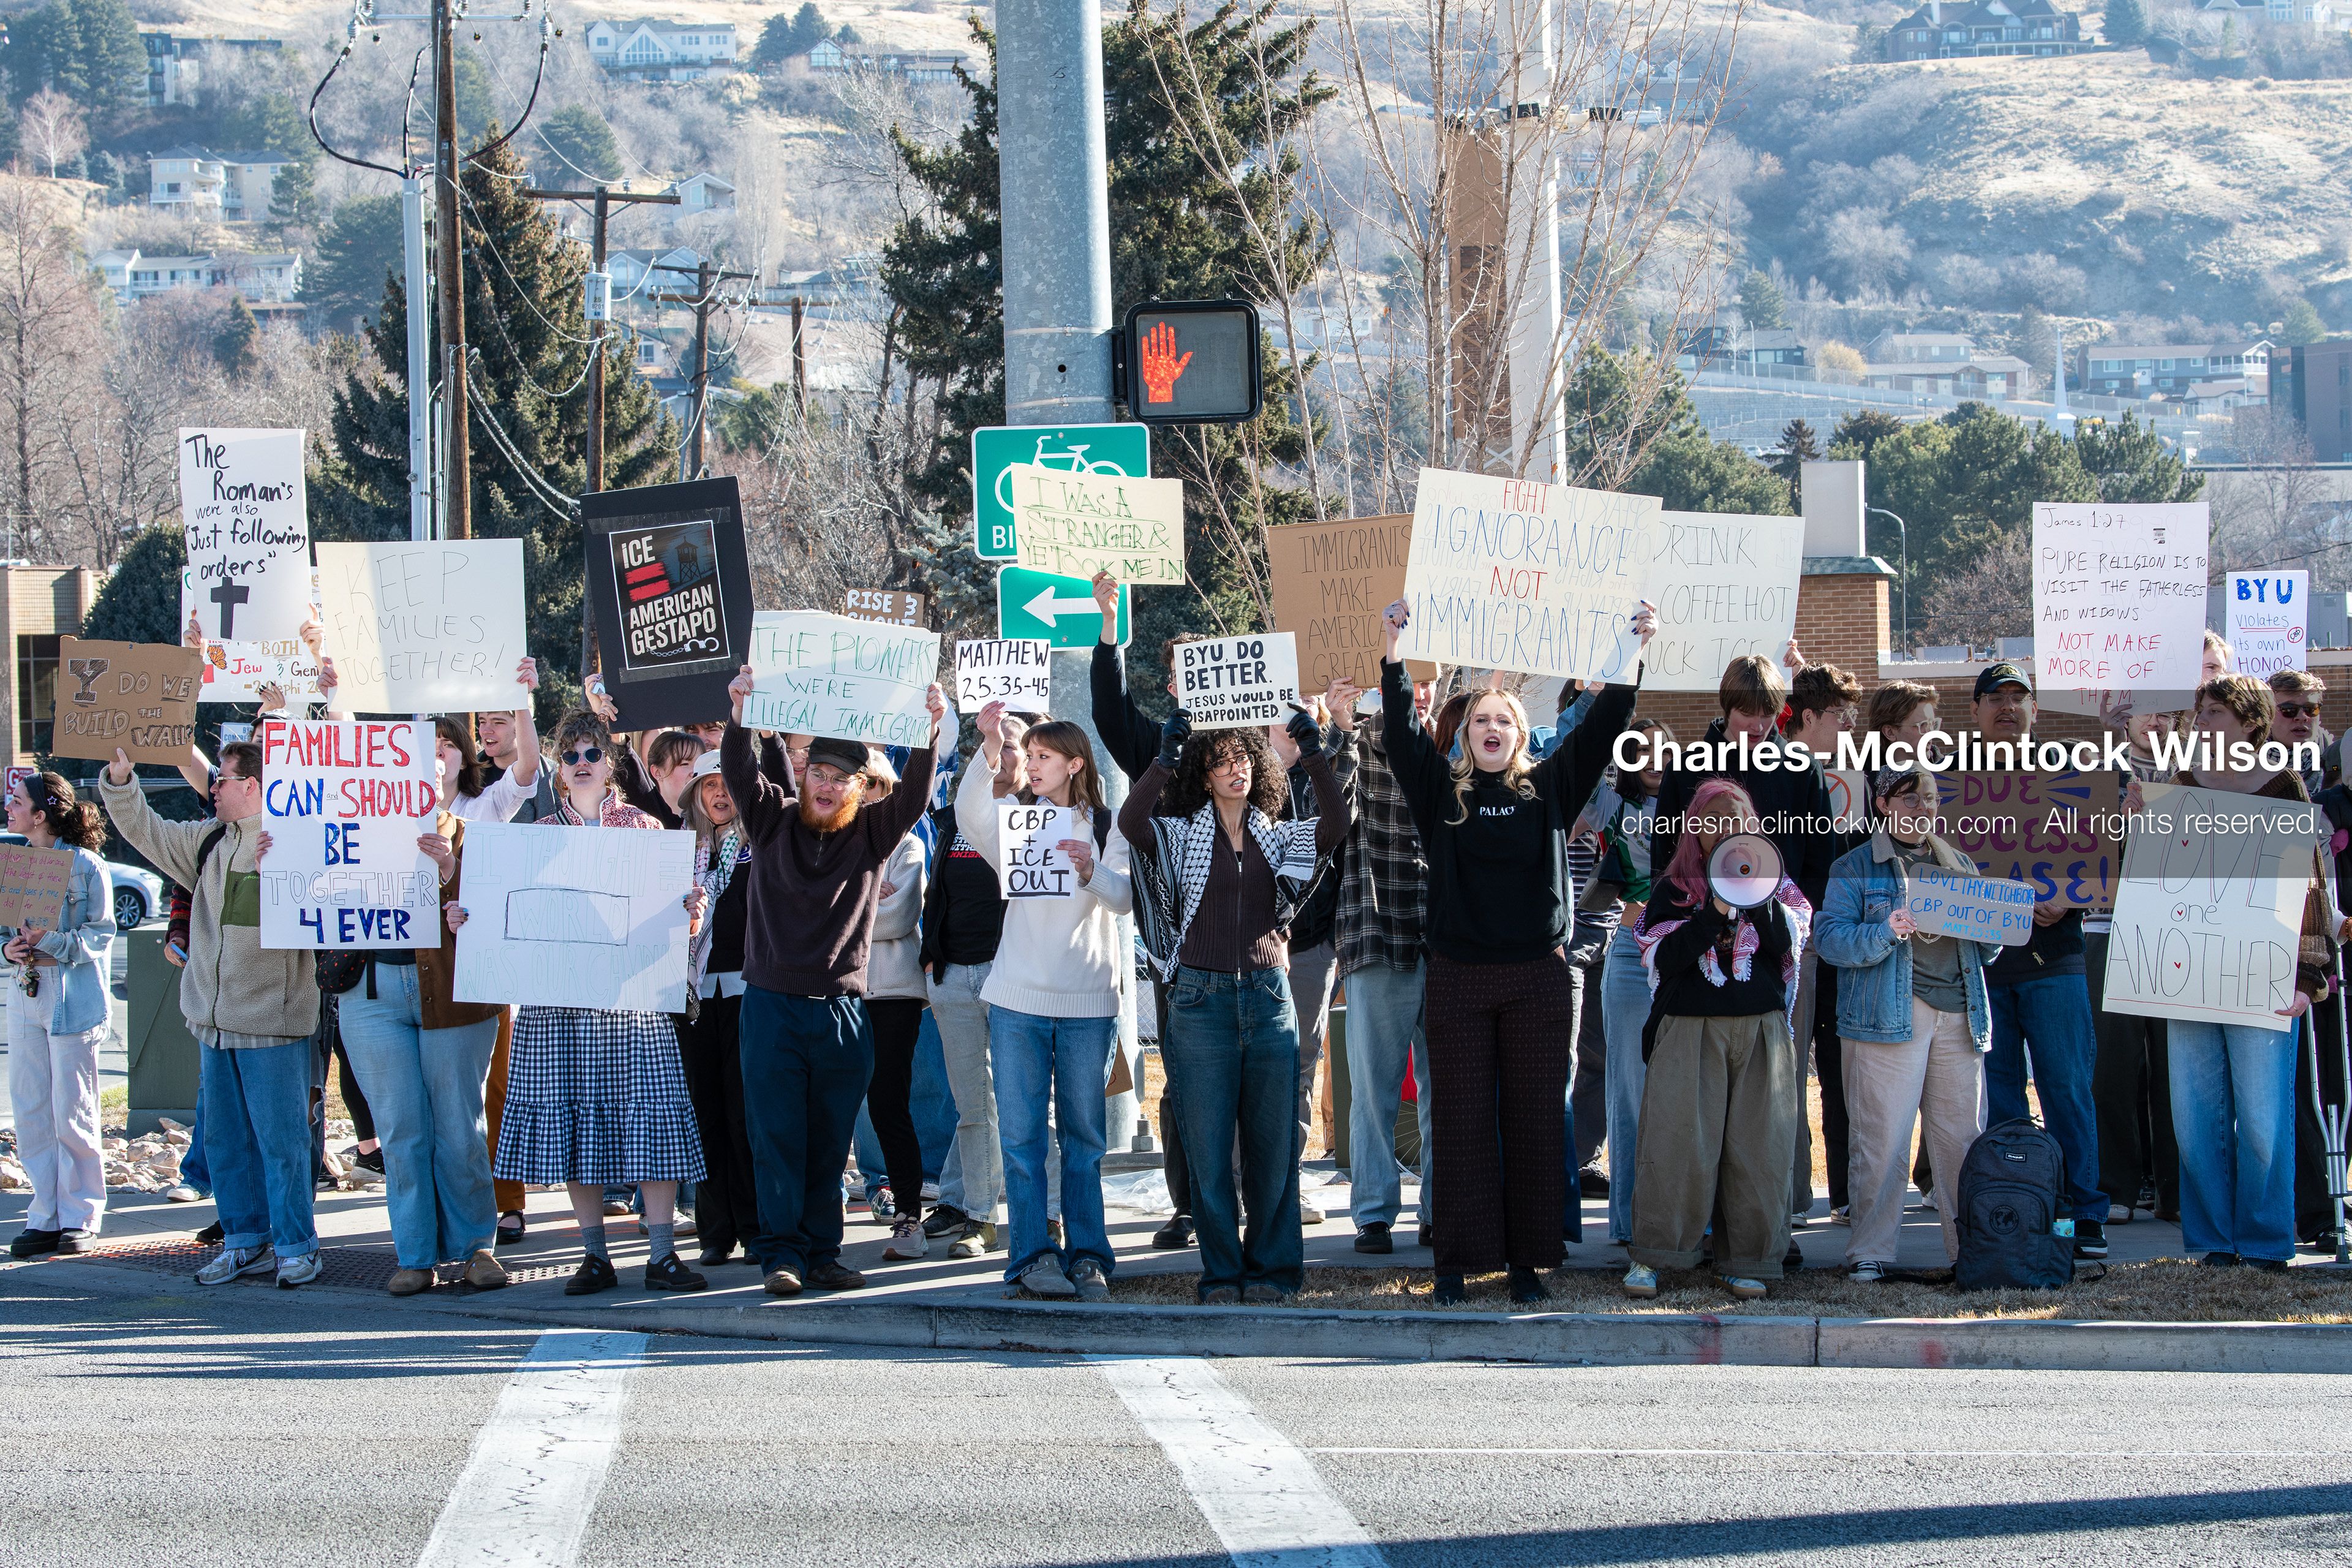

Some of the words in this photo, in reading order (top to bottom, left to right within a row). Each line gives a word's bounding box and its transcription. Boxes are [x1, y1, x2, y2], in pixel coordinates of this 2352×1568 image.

[185, 434, 230, 470] The
[213, 470, 294, 502] Roman's
[1030, 477, 1055, 509] I
[1059, 481, 1111, 518] WAS
[1114, 485, 1133, 519] A
[1503, 480, 1552, 514] FIGHT
[195, 505, 224, 519] were
[231, 501, 258, 515] also
[2040, 507, 2081, 528] James
[2089, 510, 2125, 529] 1:27
[230, 518, 306, 552] following
[1026, 509, 1147, 549] STRANGER
[1148, 522, 1172, 551] &
[1434, 504, 1633, 576] IGNORANCE
[1653, 521, 1757, 569] DRINK
[1049, 545, 1117, 581] TOOK
[1121, 558, 1153, 579] ME
[1157, 558, 1183, 581] IN
[1298, 524, 1412, 575] IMMIGRANTS
[2042, 547, 2087, 575] PURE
[2099, 553, 2166, 575] RELIGION
[2173, 555, 2190, 570] IS
[2195, 557, 2207, 569] TO
[345, 551, 469, 614] KEEP
[1320, 576, 1374, 614] MAKE
[1490, 565, 1548, 601] NOT
[2041, 579, 2089, 596] VISIT
[2100, 579, 2129, 594] THE
[2139, 579, 2206, 599] FATHERLESS
[2236, 578, 2293, 605] BYU
[630, 584, 714, 630] AMERICAN
[846, 589, 894, 613] RISE
[1659, 584, 1740, 625] COFFEE
[1744, 586, 1792, 622] HOT
[2043, 605, 2069, 622] AND
[260, 639, 300, 655] BOTH
[334, 611, 486, 650] FAMILIES
[631, 607, 717, 656] GESTAPO
[1415, 591, 1626, 678] IMMIGRANTS
[2057, 631, 2095, 650] NOT
[2104, 633, 2162, 652] MAKE
[2234, 636, 2249, 652] its
[2257, 639, 2285, 651] own
[2290, 629, 2301, 641] CBP
[230, 658, 262, 674] Jew
[339, 643, 505, 688] TOGETHER!
[751, 625, 818, 669] THE
[830, 630, 938, 688] PIONEERS
[958, 639, 1049, 671] MATTHEW
[1183, 643, 1228, 668] BYU,
[1237, 640, 1264, 660] DO
[1648, 640, 1698, 676] UCK
[2048, 657, 2111, 679] MORE
[2127, 661, 2156, 679] OF
[2237, 655, 2295, 674] HONOR
[68, 657, 110, 703] Y
[118, 671, 151, 696] DO
[162, 674, 193, 698] WE
[785, 673, 861, 699] WERE
[962, 676, 1049, 701] 25:35-45
[1185, 660, 1273, 692] BETTER.
[1185, 693, 1226, 709] JESUS
[1231, 690, 1274, 704] WOULD
[1279, 688, 1293, 701] BE
[64, 709, 130, 740] BUILD
[138, 707, 162, 719] THE
[747, 690, 824, 732] ILLEGAL
[832, 707, 932, 747] IMMIGRANTS
[264, 722, 412, 768] FAMILIES
[266, 778, 324, 817] CAN
[326, 791, 338, 800] and
[337, 778, 437, 818] SHOULD
[1963, 774, 2040, 806] DUE
[1008, 809, 1057, 831] CBP
[324, 822, 361, 866] BE
[1007, 848, 1055, 867] ICE
[2124, 791, 2298, 914] LOVE
[466, 827, 507, 884] I
[521, 827, 662, 898] THOUGHT
[262, 870, 437, 908] TOGETHER
[1008, 869, 1070, 893] OUT
[1919, 867, 1959, 891] LOVE
[1962, 877, 1985, 898] THY
[1984, 883, 2034, 905] NEIGHBOR
[300, 907, 326, 944] 4
[337, 907, 411, 943] EVER
[514, 889, 627, 945] WORLD
[1910, 897, 1943, 913] CBP
[1947, 904, 1975, 921] OUT
[1975, 909, 1997, 924] OF
[2002, 912, 2031, 930] BYU
[1942, 921, 1970, 935] MATT
[2170, 902, 2222, 925] one
[456, 944, 519, 1001] WAS
[531, 943, 583, 1001] OUR
[586, 941, 687, 1011] CAMPUS
[2104, 921, 2290, 1011] ANOTHER
